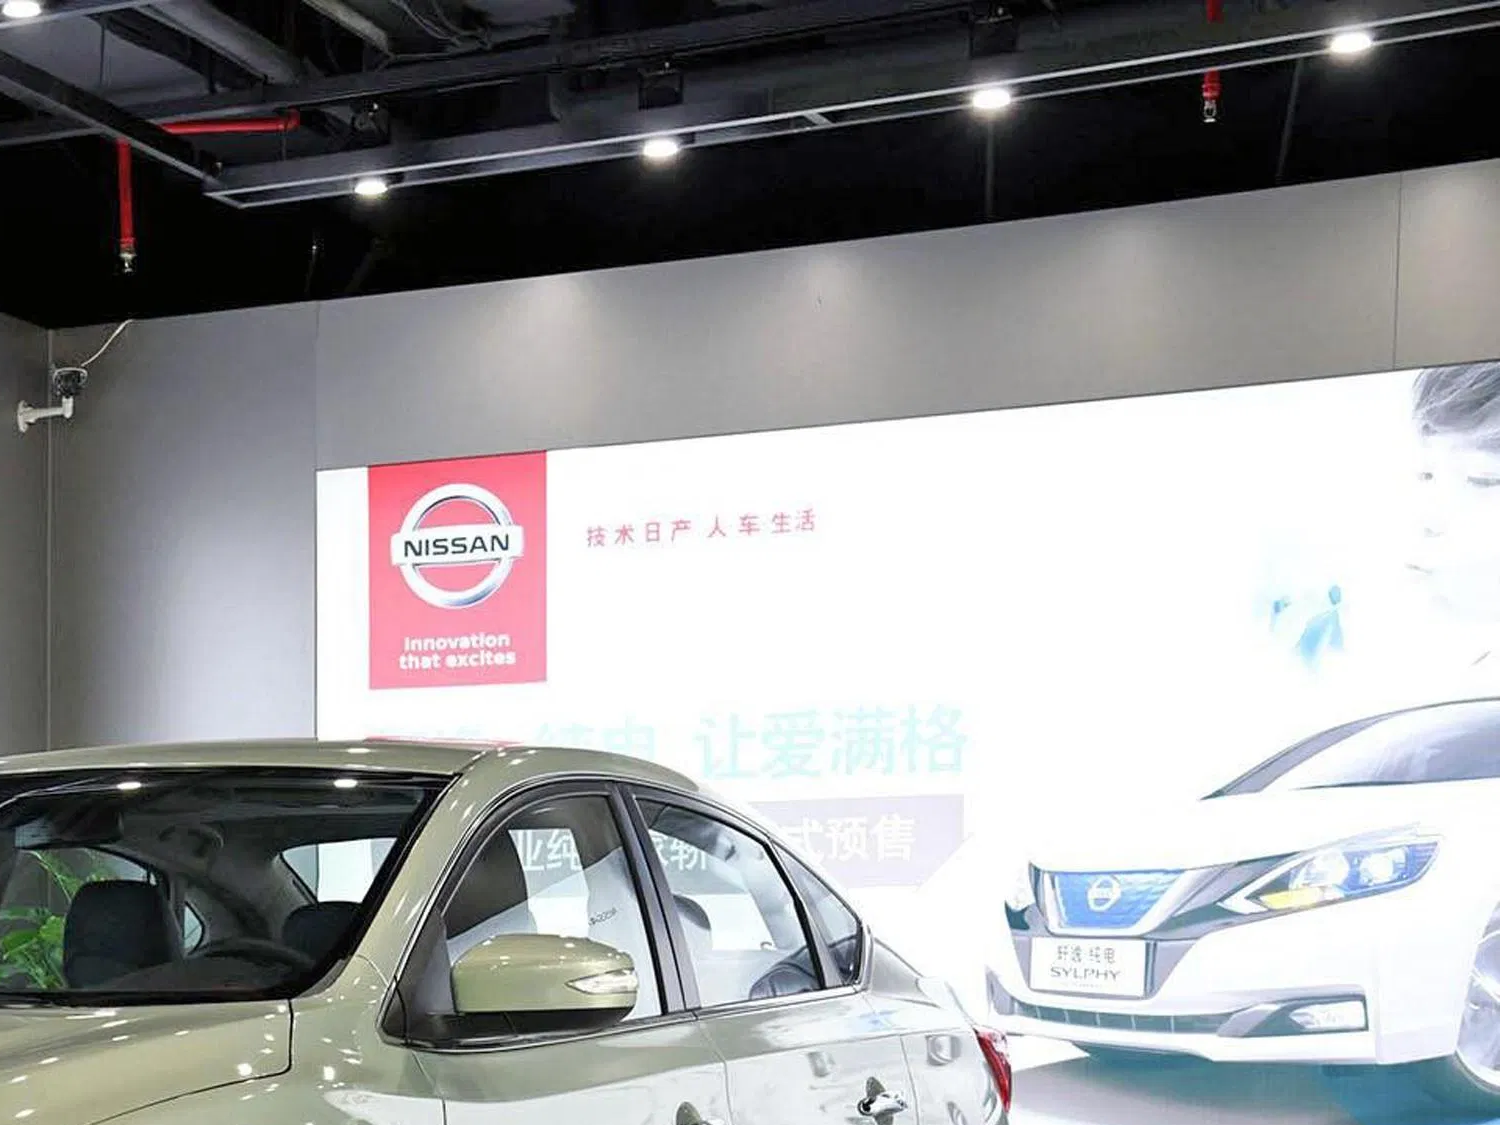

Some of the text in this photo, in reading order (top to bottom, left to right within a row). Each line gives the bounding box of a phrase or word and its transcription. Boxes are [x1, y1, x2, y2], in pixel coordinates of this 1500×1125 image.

[403, 532, 510, 558] NISSAN
[399, 650, 517, 671] that excites
[694, 703, 971, 780] 让爱满格
[1050, 966, 1122, 982] SYLPHY
